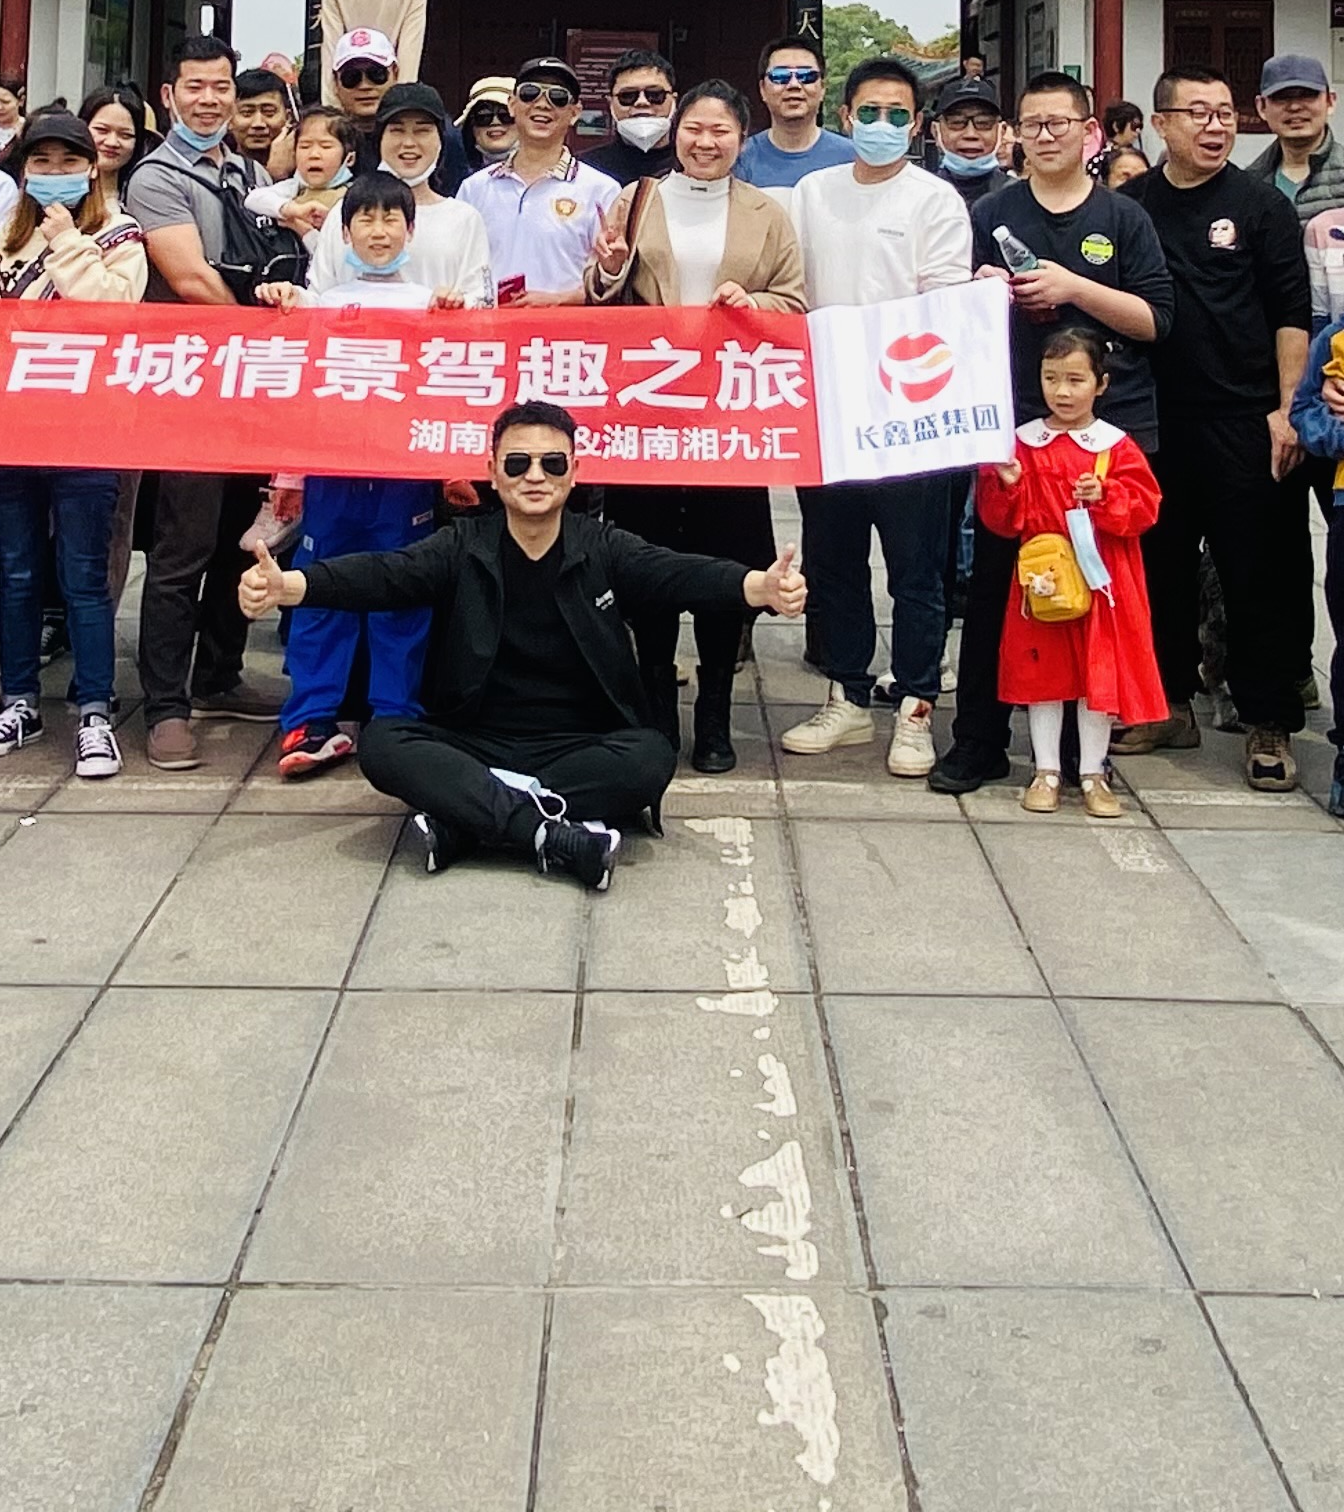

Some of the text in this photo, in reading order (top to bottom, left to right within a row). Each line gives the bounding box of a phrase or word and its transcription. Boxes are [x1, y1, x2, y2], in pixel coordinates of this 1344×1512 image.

[855, 404, 1001, 451] 长鑫盛集团
